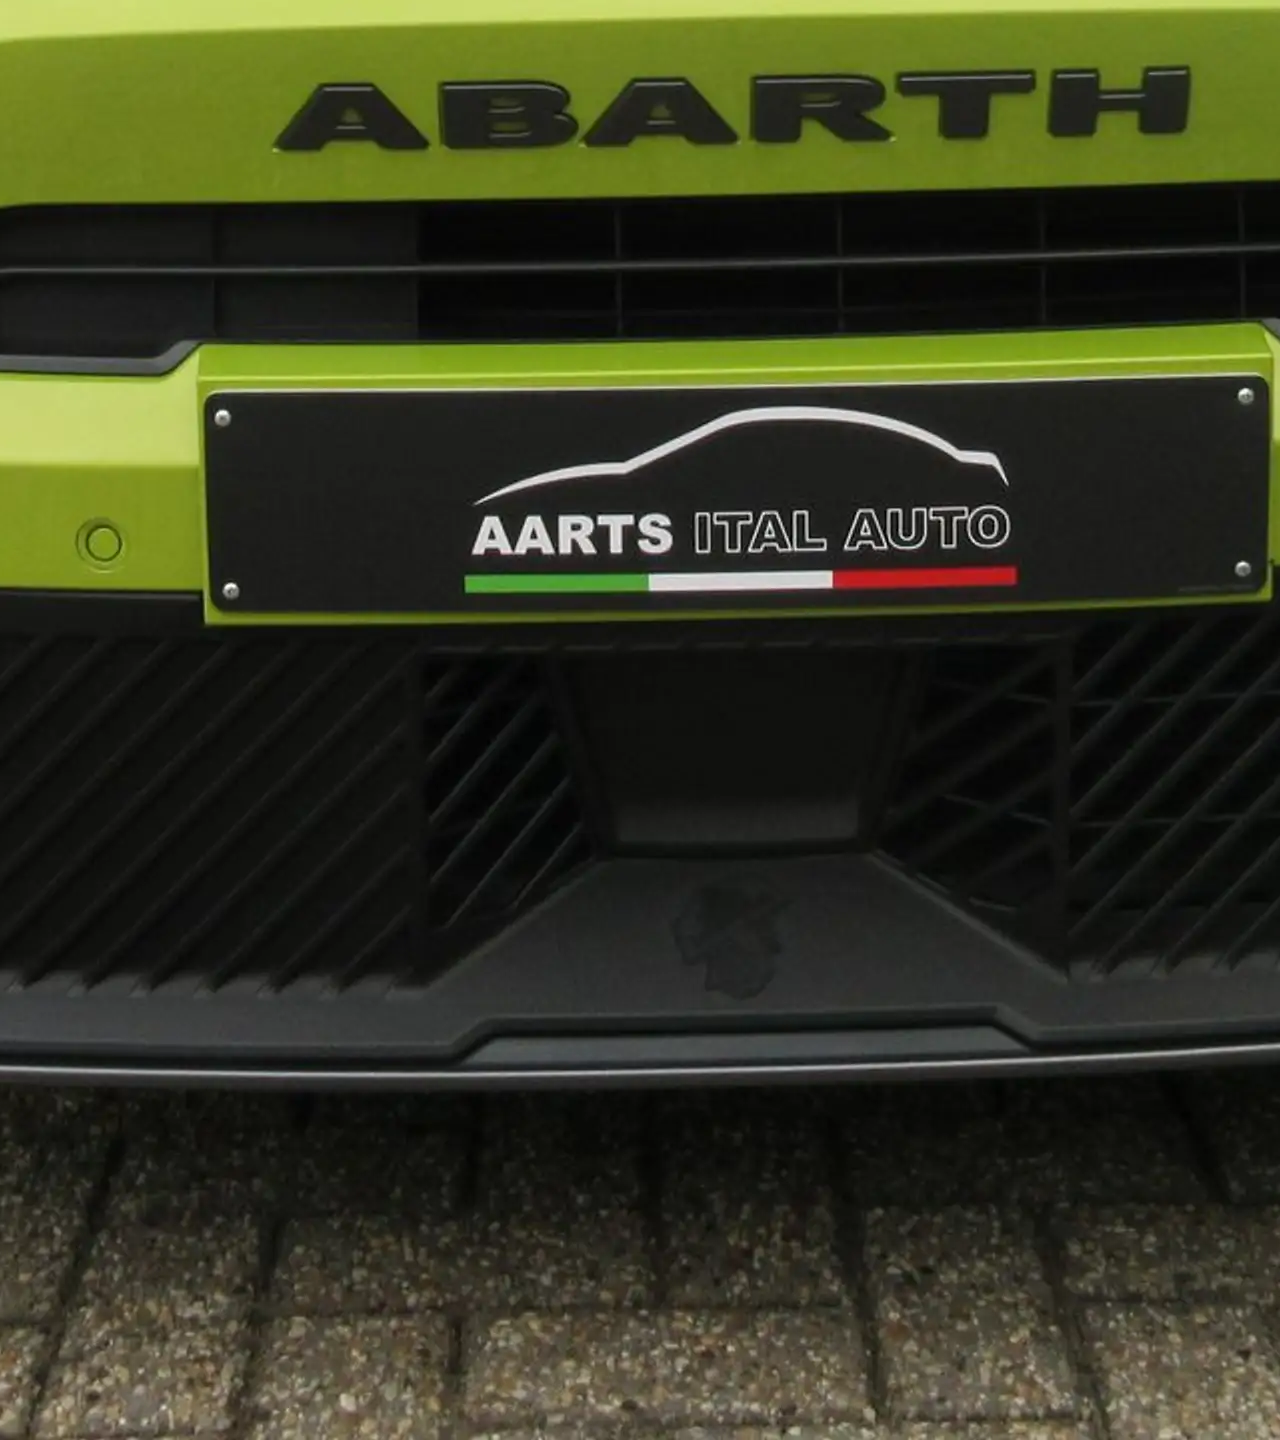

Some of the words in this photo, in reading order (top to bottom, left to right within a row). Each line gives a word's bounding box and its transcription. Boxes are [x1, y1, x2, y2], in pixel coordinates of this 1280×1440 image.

[273, 66, 1192, 152] ABARTH
[471, 513, 675, 556] AARTS
[694, 510, 828, 554] ITAL
[844, 505, 1014, 551] AUTO
